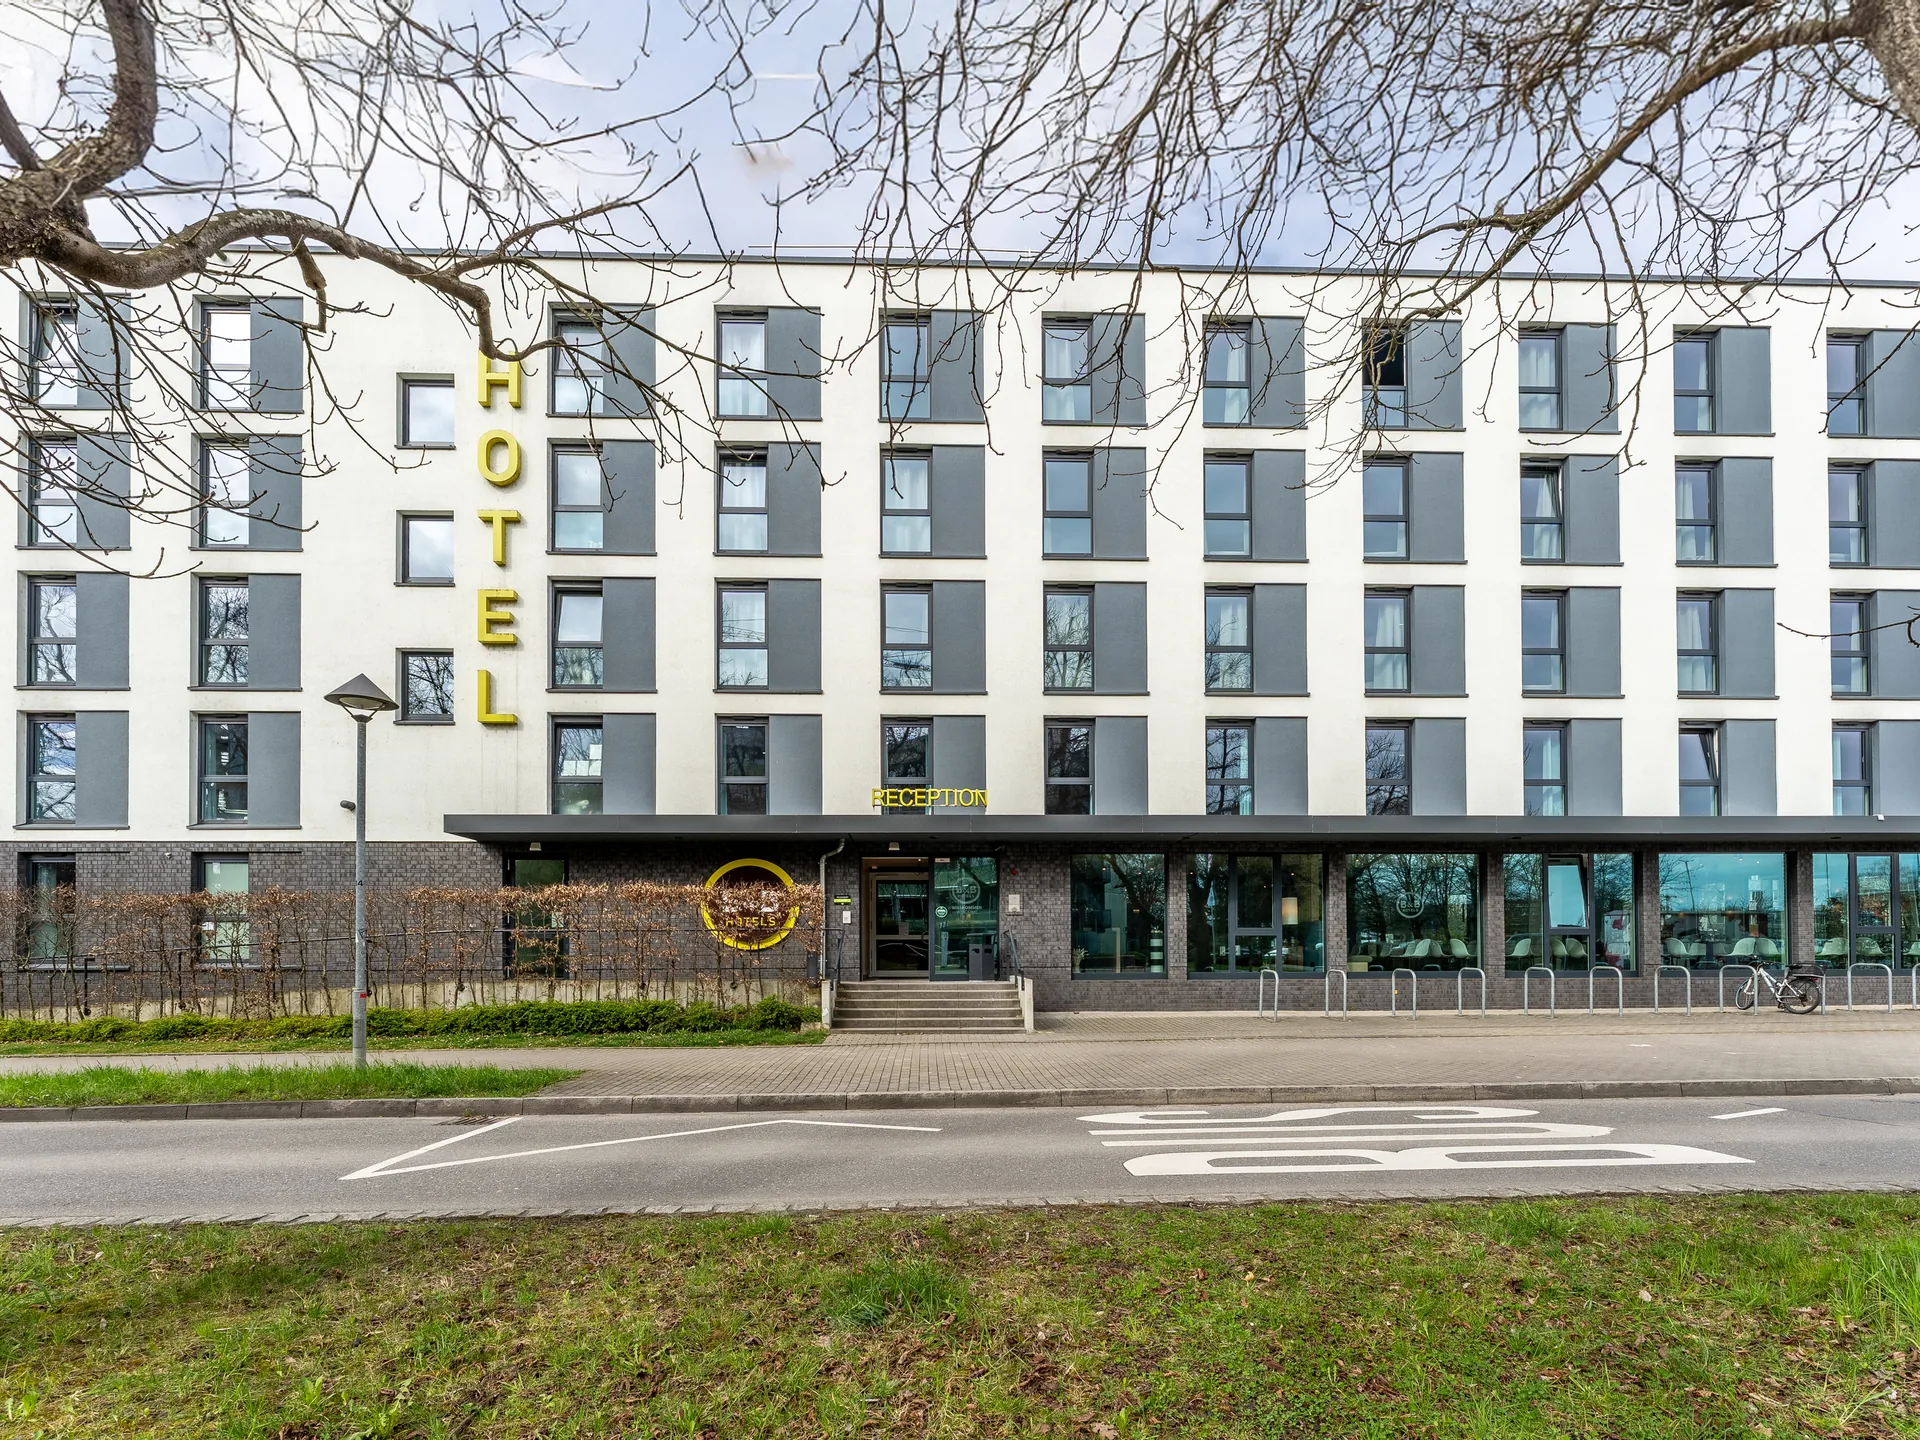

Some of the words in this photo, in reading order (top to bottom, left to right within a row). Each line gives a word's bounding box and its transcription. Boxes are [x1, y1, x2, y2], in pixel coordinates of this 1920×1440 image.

[477, 349, 522, 725] HOTEL
[871, 787, 988, 807] RECEPTION
[1076, 1106, 1755, 1176] BUS
